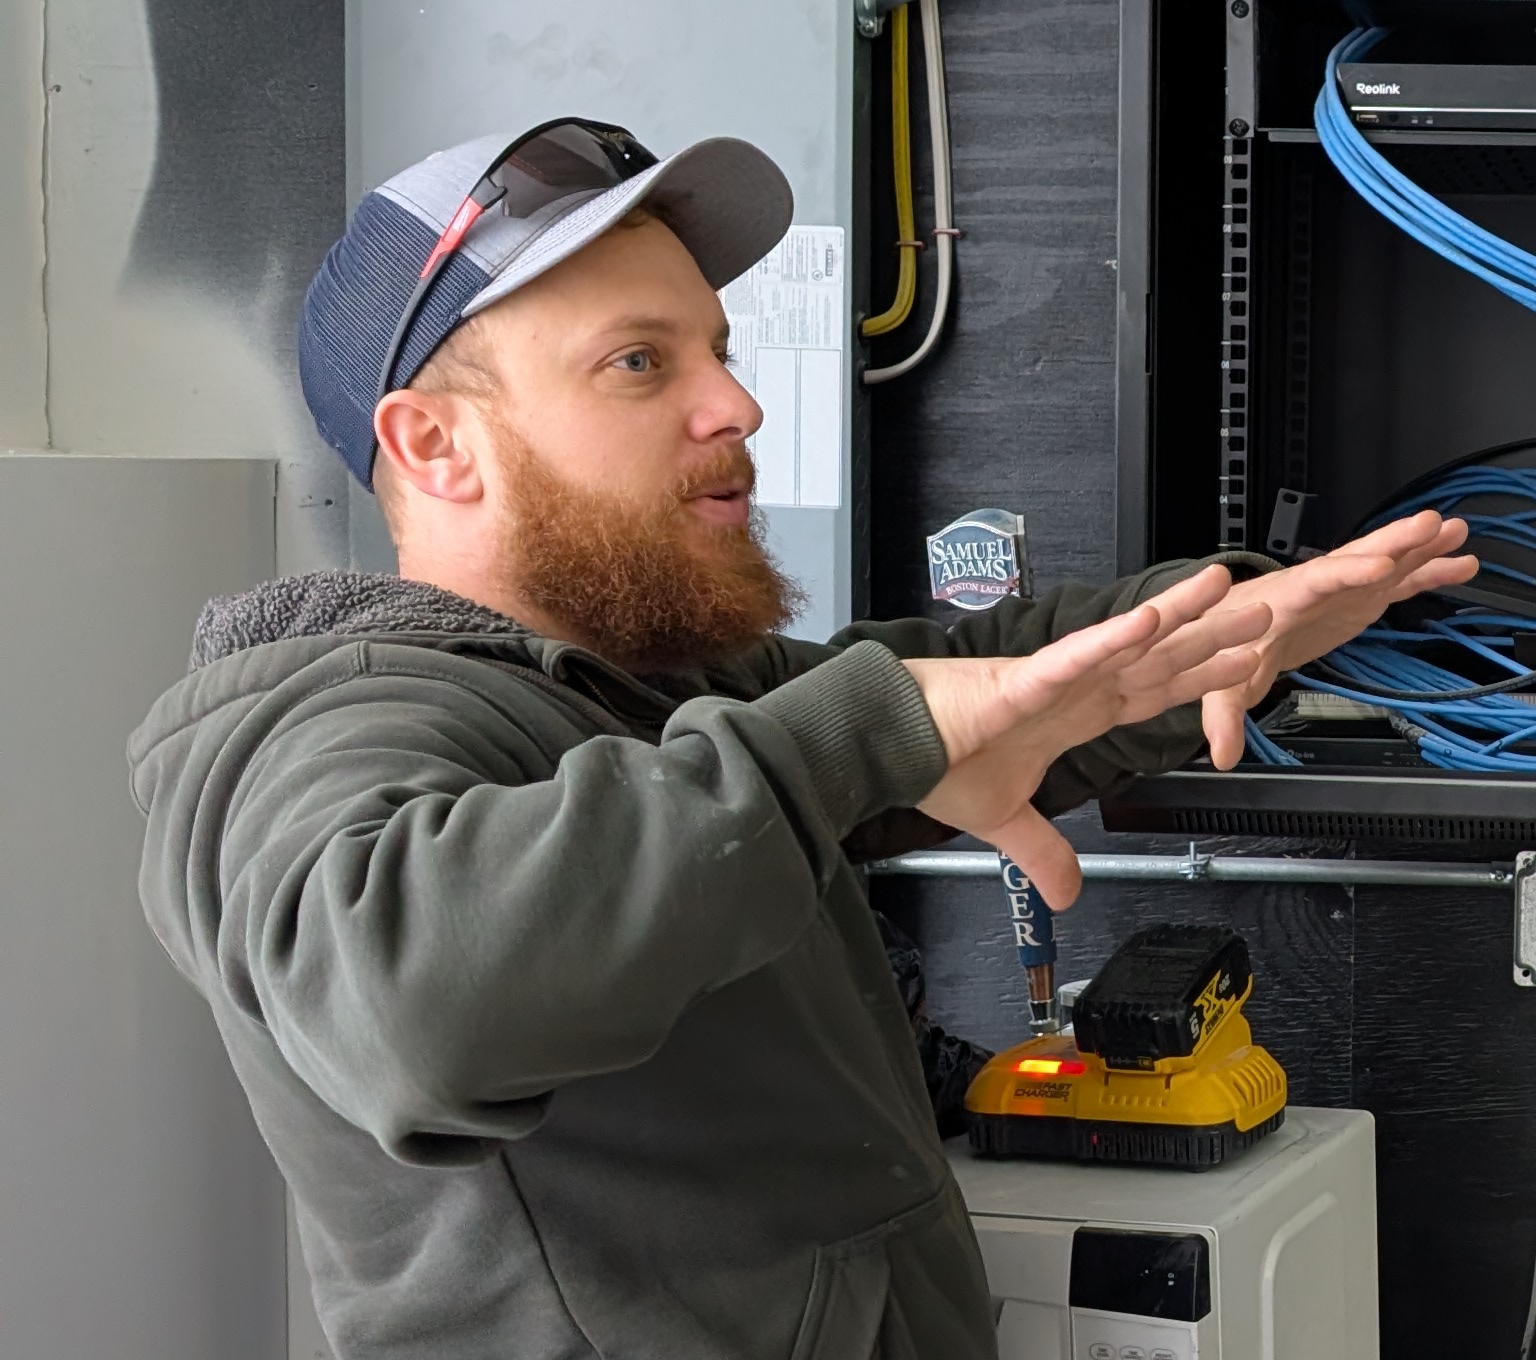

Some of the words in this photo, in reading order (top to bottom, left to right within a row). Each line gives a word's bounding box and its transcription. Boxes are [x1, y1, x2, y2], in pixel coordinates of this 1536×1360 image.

[1356, 83, 1401, 95] Reolink
[1223, 154, 1233, 165] 09
[1221, 292, 1231, 302] 07
[1219, 495, 1228, 504] 04
[931, 538, 1012, 565] SAMUEL
[940, 560, 1008, 585] ADAMS
[945, 582, 979, 595] BOSTON
[979, 584, 1007, 594] LAGER
[997, 848, 1043, 947] GER
[1041, 1082, 1073, 1090] FAST
[1014, 1089, 1071, 1101] CHARGER
